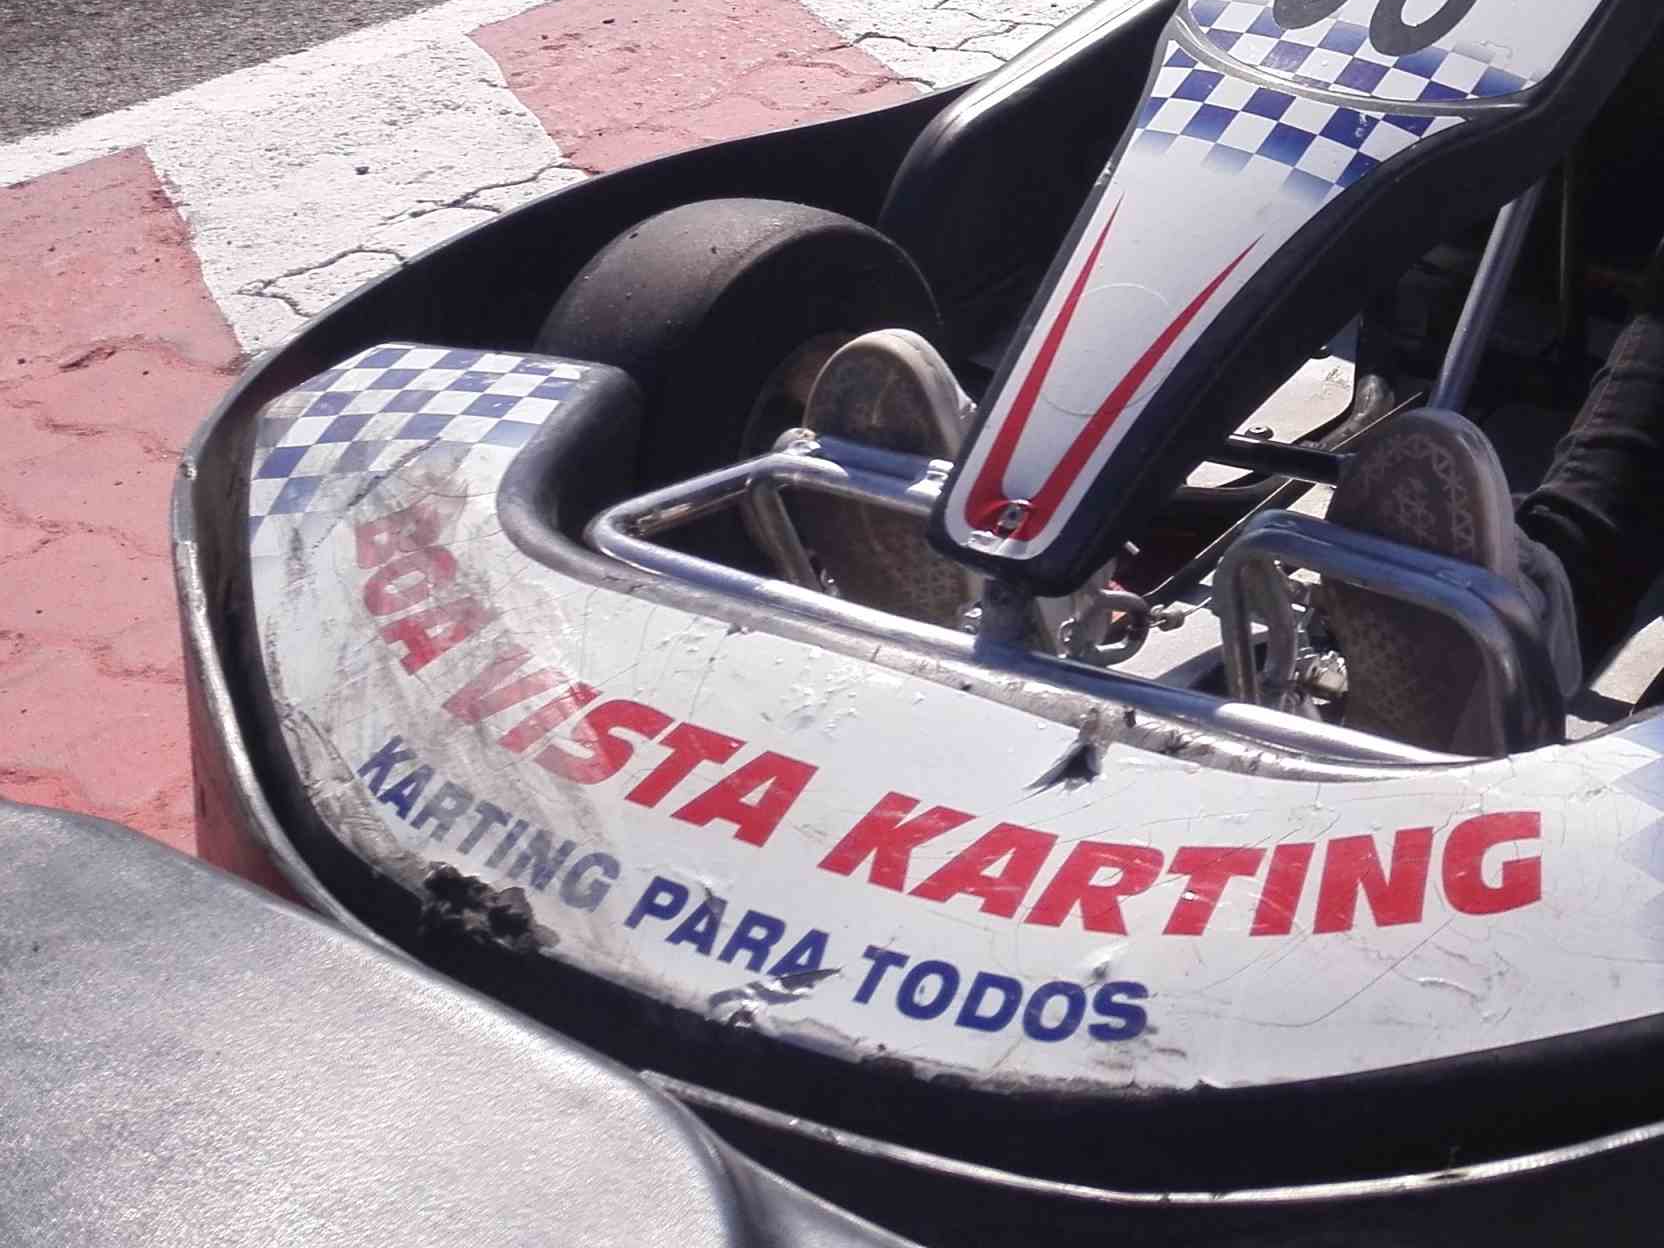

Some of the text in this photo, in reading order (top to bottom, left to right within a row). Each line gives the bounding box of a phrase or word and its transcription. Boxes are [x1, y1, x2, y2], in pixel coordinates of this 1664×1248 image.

[354, 502, 1542, 937] BOA VISTA KARTING
[357, 734, 1150, 1042] KARTING PARA TODOS
